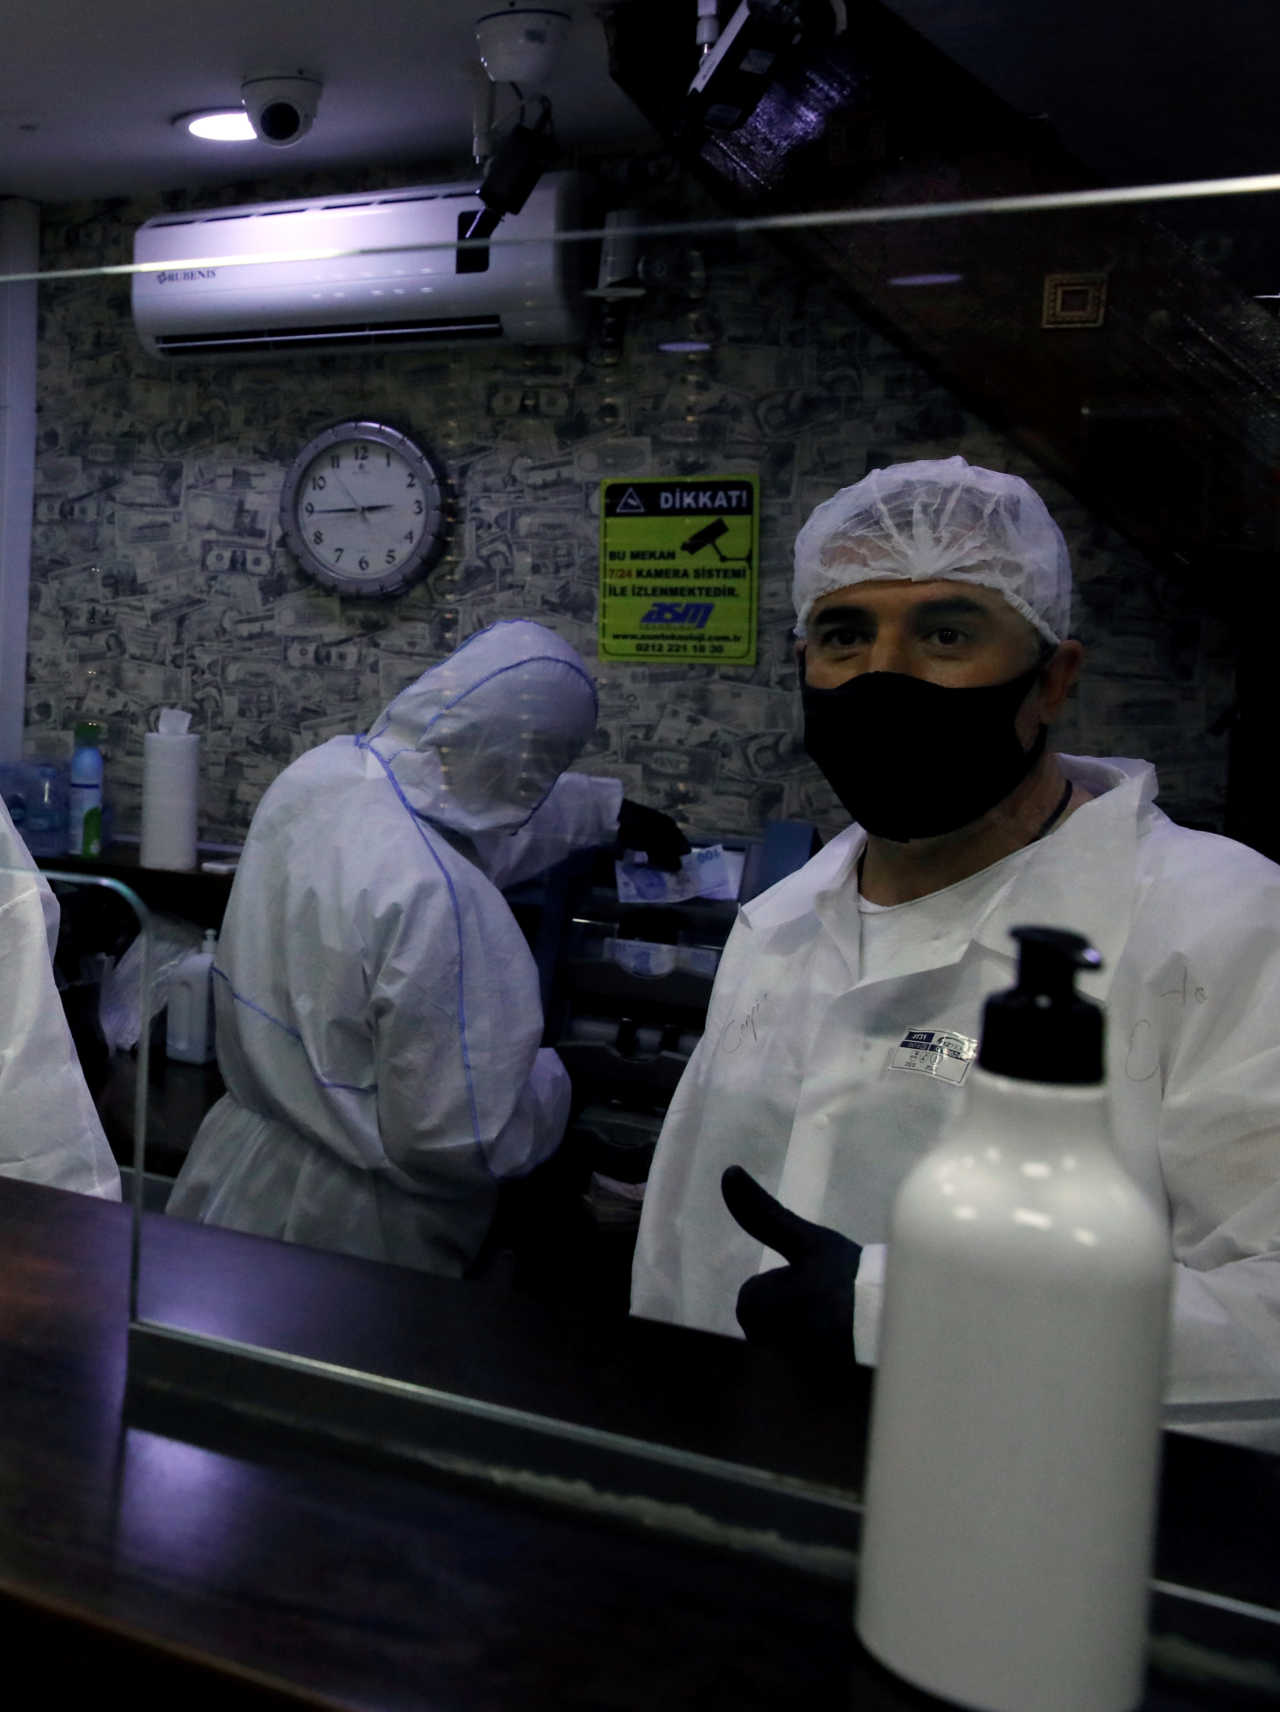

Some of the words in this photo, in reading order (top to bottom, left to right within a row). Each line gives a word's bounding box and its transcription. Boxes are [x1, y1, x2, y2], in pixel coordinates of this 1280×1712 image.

[167, 269, 217, 281] RUBENIS
[354, 445, 369, 460] 12
[331, 455, 340, 469] 11
[312, 476, 326, 491] 10
[406, 472, 416, 488] 2
[659, 489, 749, 510] DİKKAT!
[305, 501, 315, 518] 9
[413, 500, 423, 516] 3
[312, 531, 323, 545] 8
[404, 530, 414, 544] 4
[334, 547, 345, 563] 7
[385, 548, 396, 565] 5
[609, 550, 626, 561] BU
[630, 550, 676, 561] MEKAN
[358, 555, 369, 571] 6
[608, 568, 633, 579] 7/24
[636, 568, 689, 579] KAMERA
[608, 584, 628, 597] İLE
